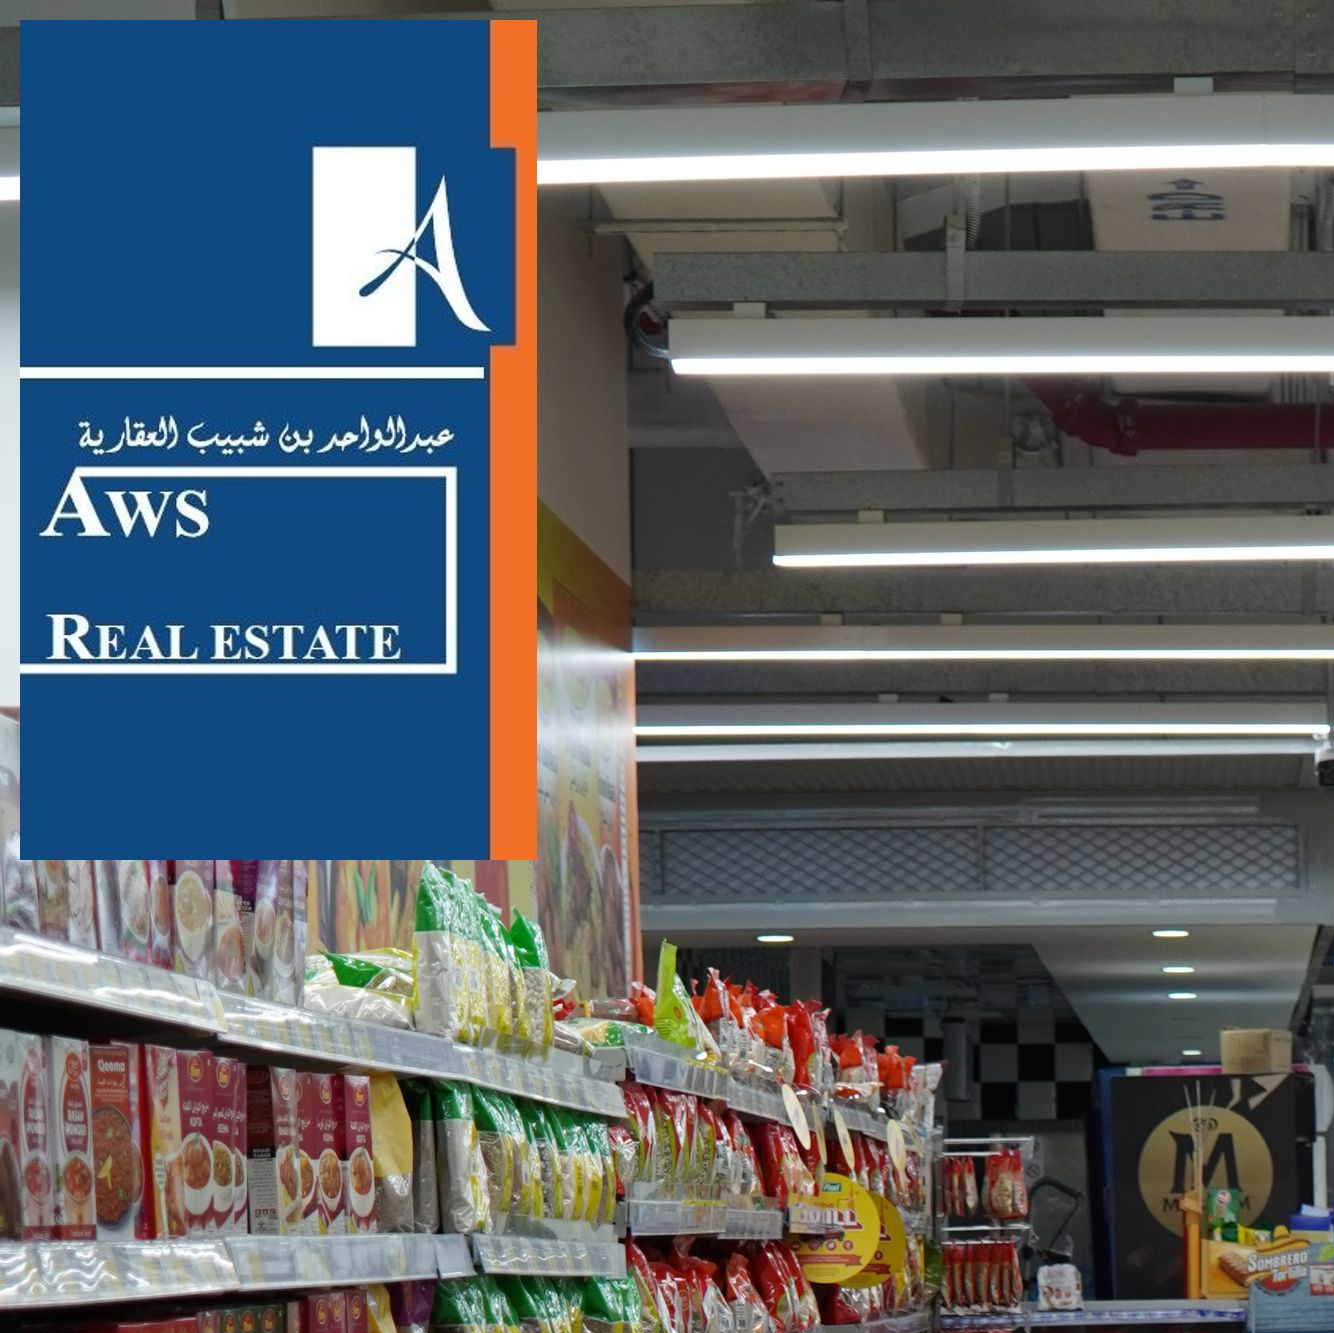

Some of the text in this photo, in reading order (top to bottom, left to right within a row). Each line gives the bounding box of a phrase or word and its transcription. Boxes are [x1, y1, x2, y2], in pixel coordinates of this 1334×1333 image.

[97, 1058, 126, 1073] Qeema
[1169, 1130, 1244, 1194] M
[1247, 1251, 1309, 1273] SOMBRERO
[1272, 1266, 1309, 1284] Tortilla
